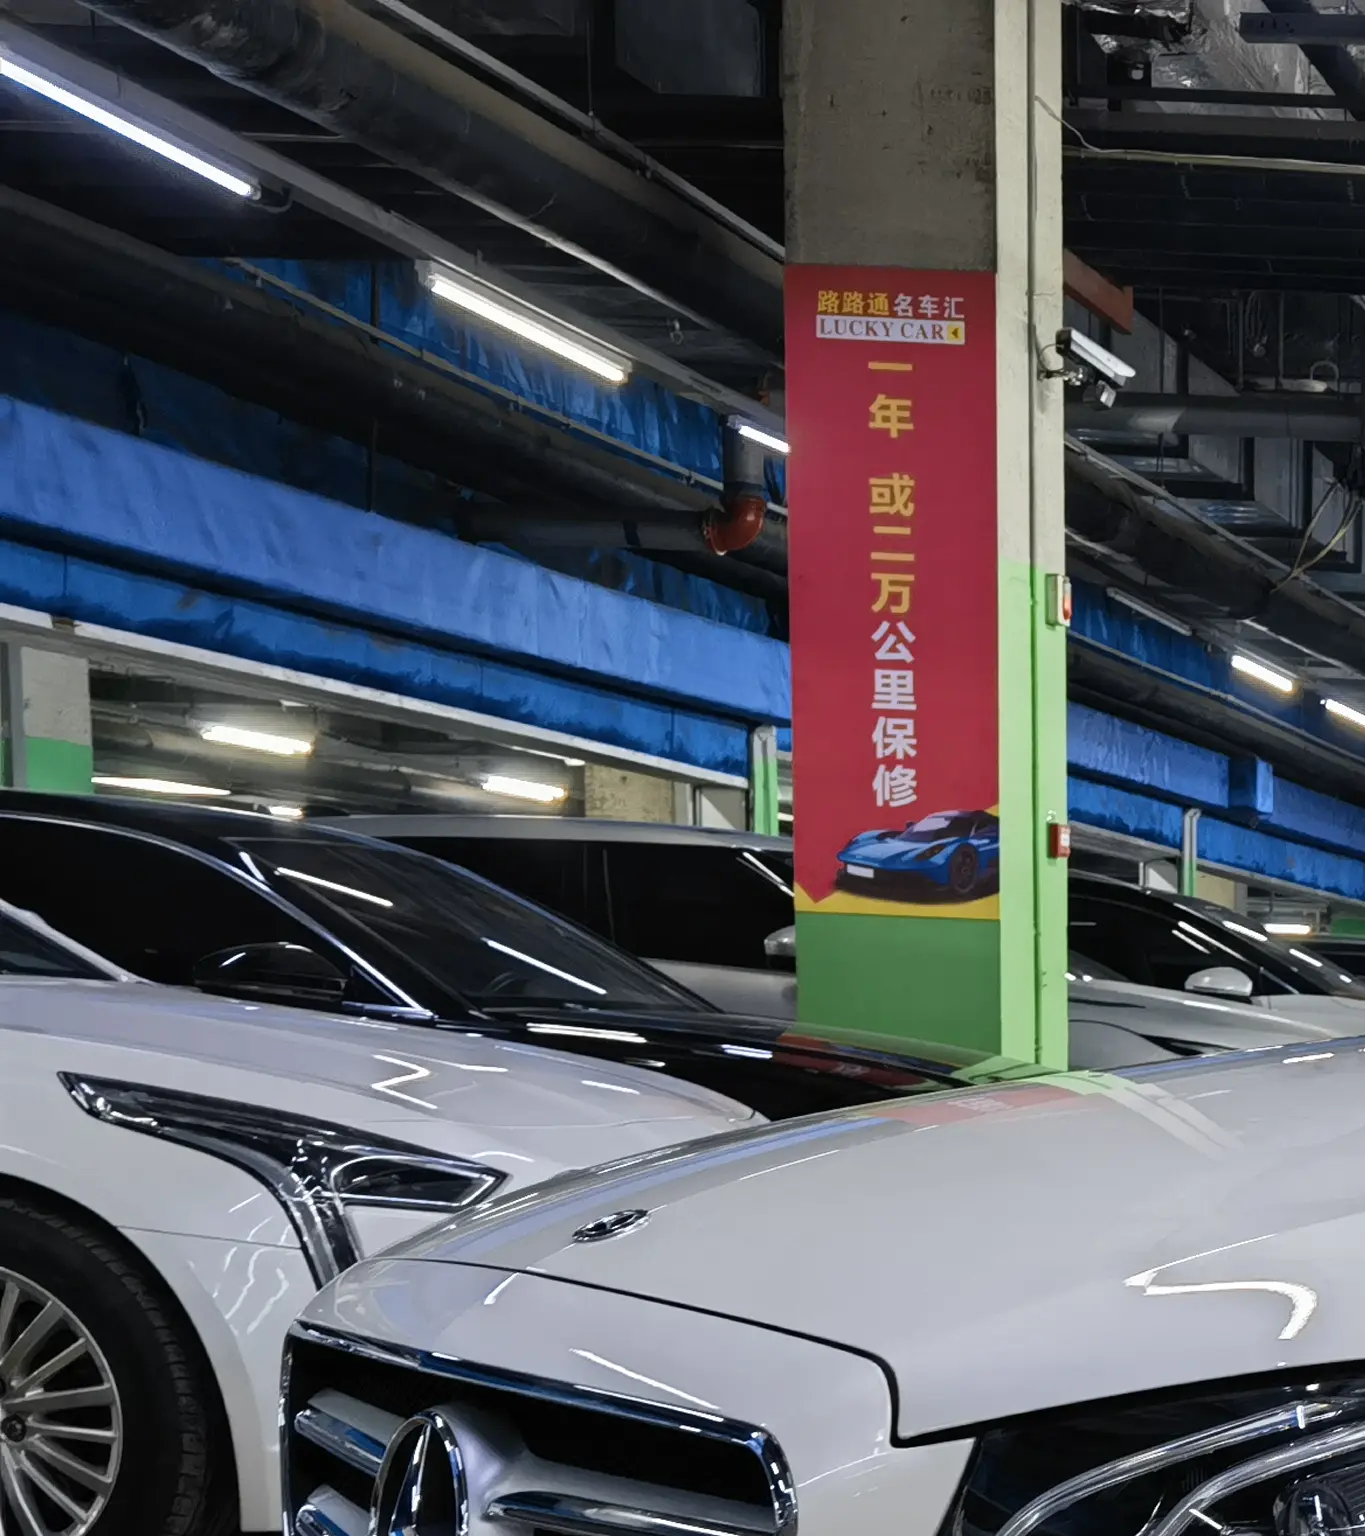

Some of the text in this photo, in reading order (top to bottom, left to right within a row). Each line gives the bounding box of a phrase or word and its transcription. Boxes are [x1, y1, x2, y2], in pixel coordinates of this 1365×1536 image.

[817, 290, 964, 319] 路路通名车汇
[819, 317, 945, 340] LUCKY CAR
